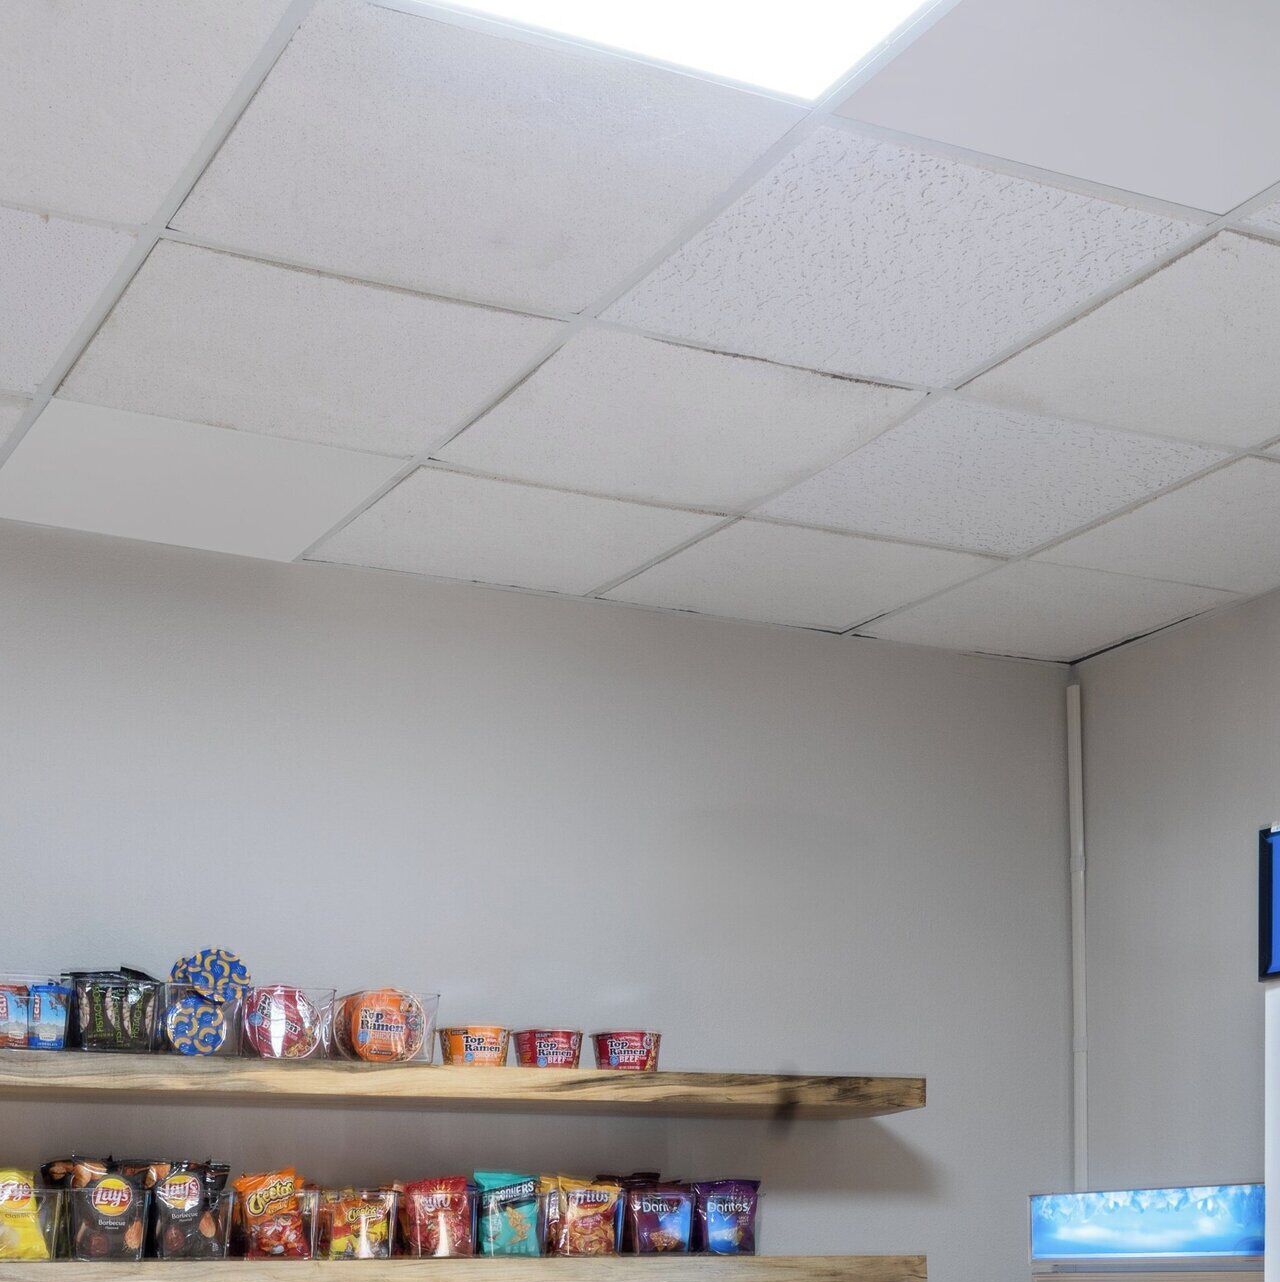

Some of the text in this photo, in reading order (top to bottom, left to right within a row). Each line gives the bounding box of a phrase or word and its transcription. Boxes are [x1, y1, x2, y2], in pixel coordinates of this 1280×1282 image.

[360, 1020, 404, 1033] Ramen
[463, 1036, 484, 1046] Top
[608, 1040, 628, 1050] Top
[464, 1044, 500, 1052] Ramen
[537, 1041, 557, 1051] Top
[538, 1049, 572, 1057] Ramen
[609, 1048, 646, 1056] Ramen
[620, 1055, 638, 1063] BEEF
[95, 1187, 130, 1207] Lay's
[249, 1180, 295, 1216] Cheetos
[171, 1212, 198, 1220] Barbecue
[98, 1219, 126, 1227] Barbecue
